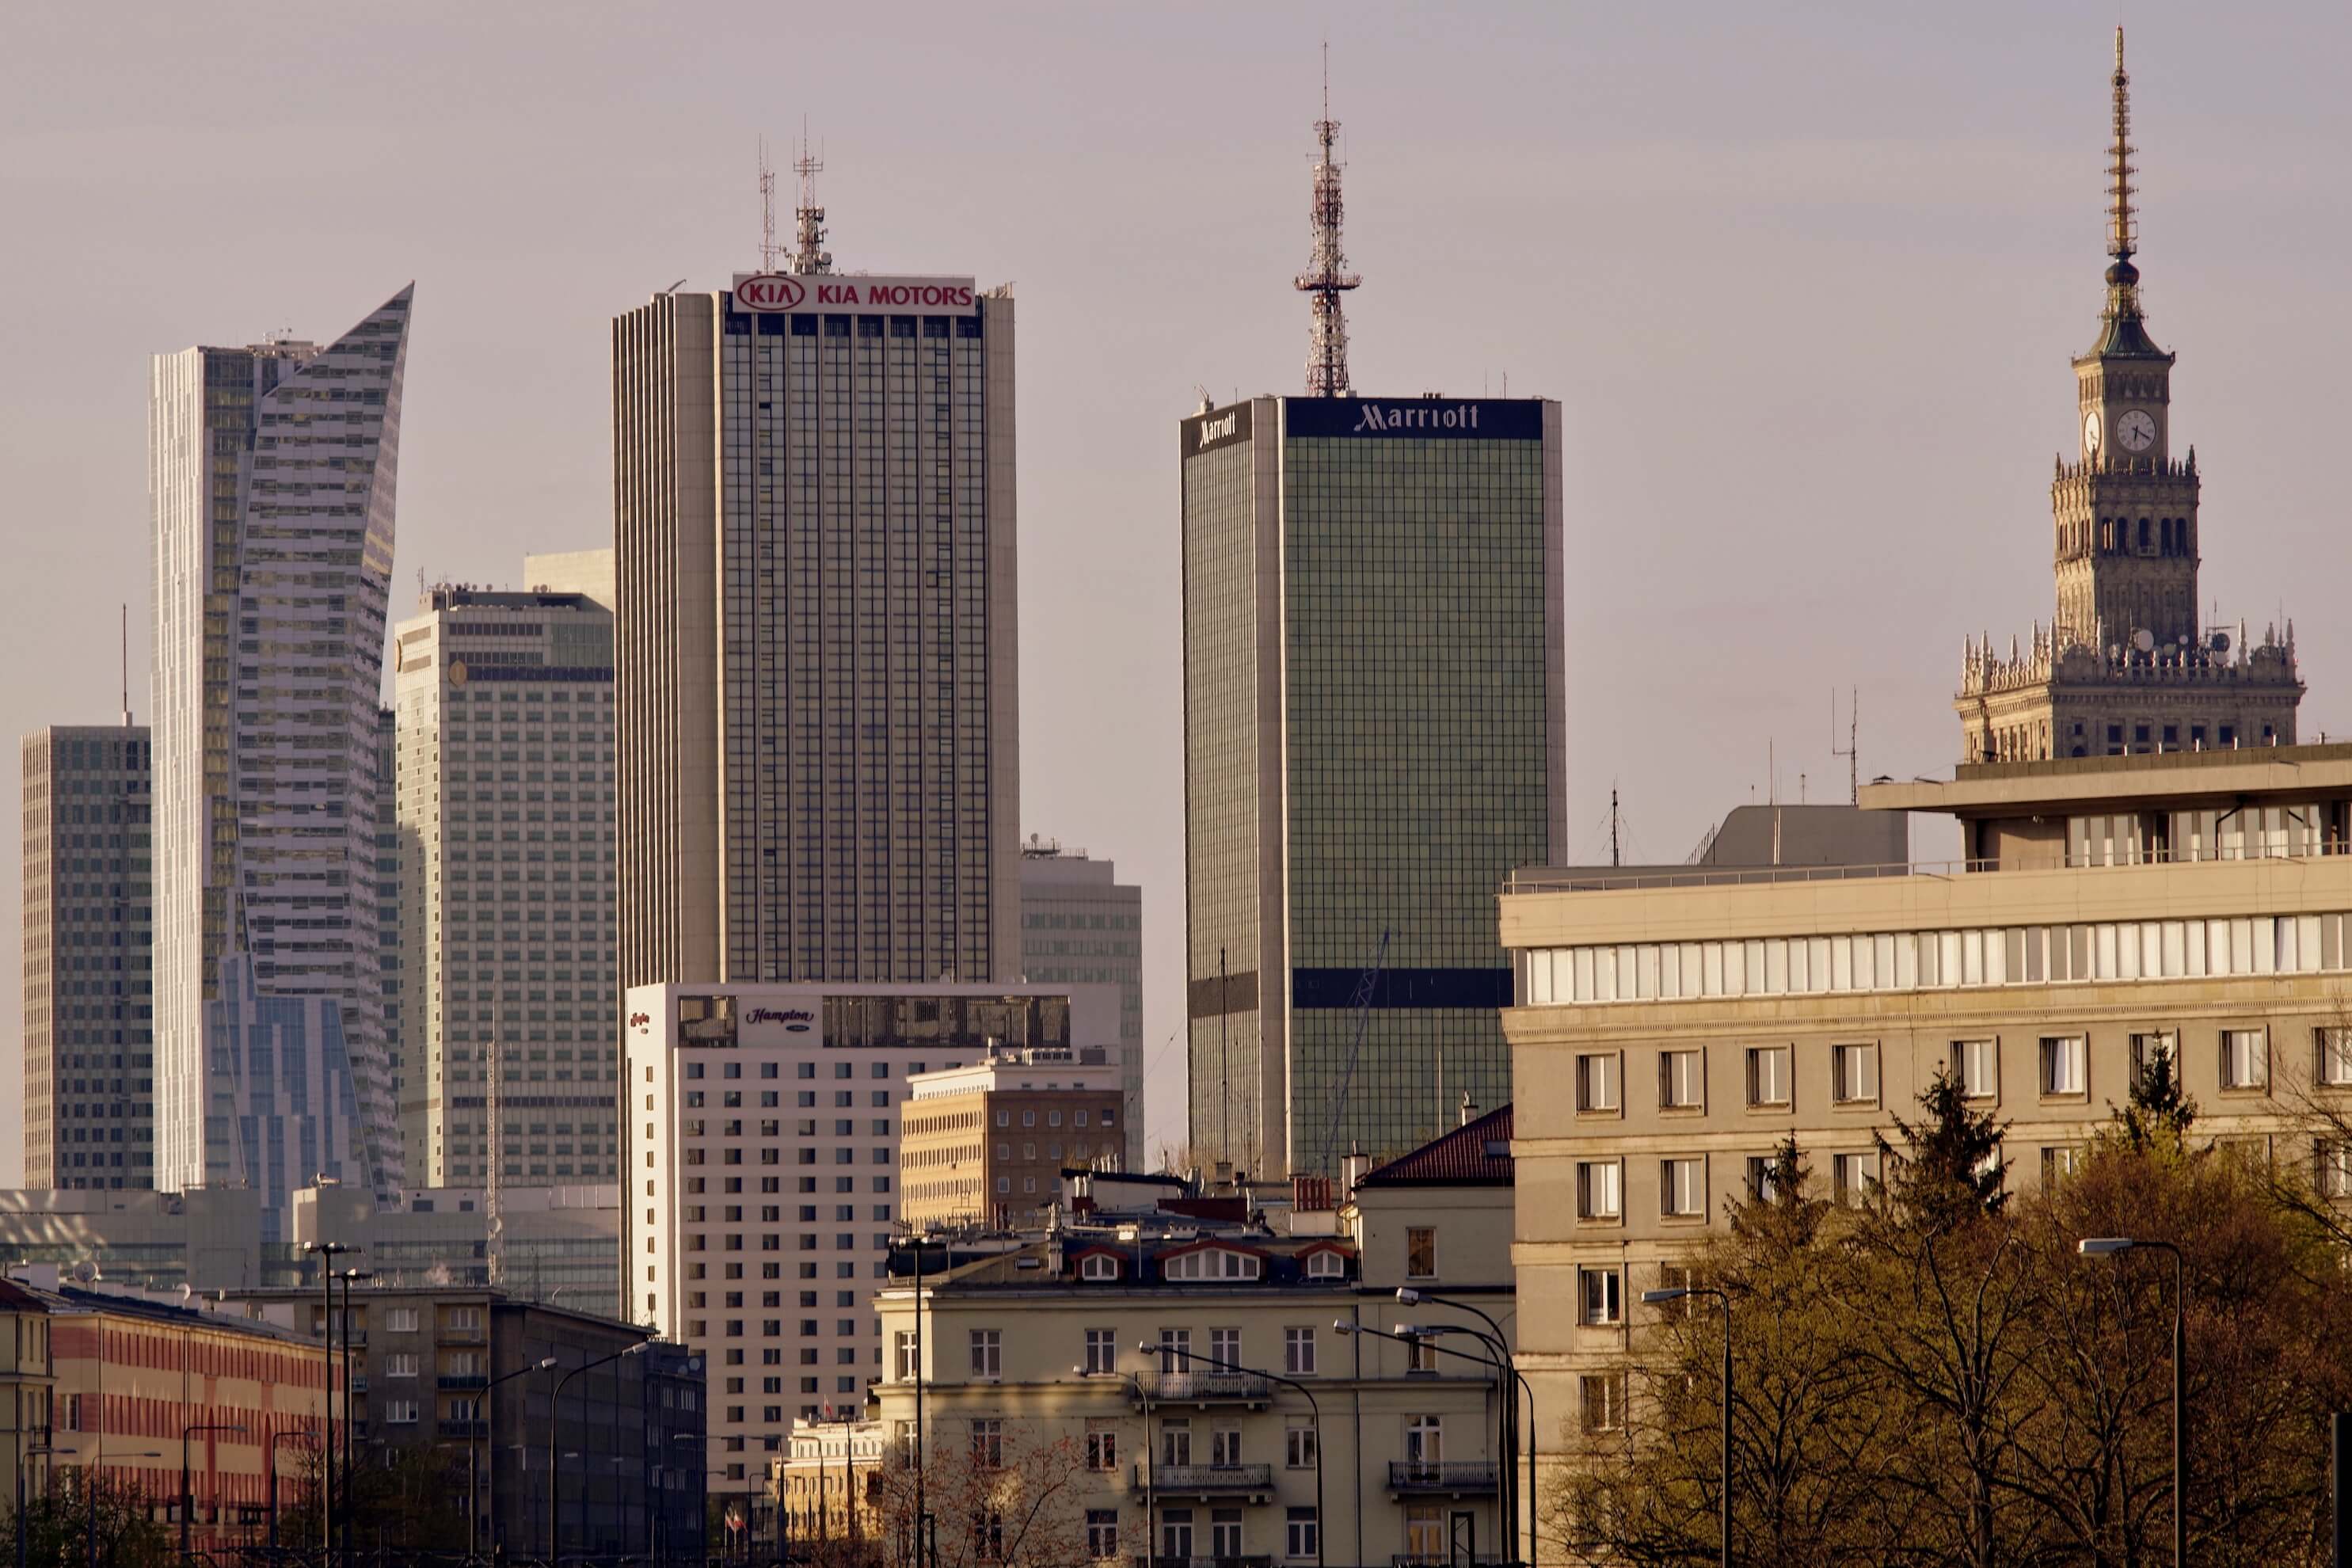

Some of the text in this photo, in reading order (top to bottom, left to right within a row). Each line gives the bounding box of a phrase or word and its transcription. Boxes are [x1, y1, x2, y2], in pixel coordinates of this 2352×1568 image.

[749, 284, 794, 303] KIA
[818, 285, 972, 306] KIA MOTORS
[1353, 404, 1478, 432] Marriott
[1199, 411, 1235, 448] Marriott
[746, 1007, 814, 1024] Hampton
